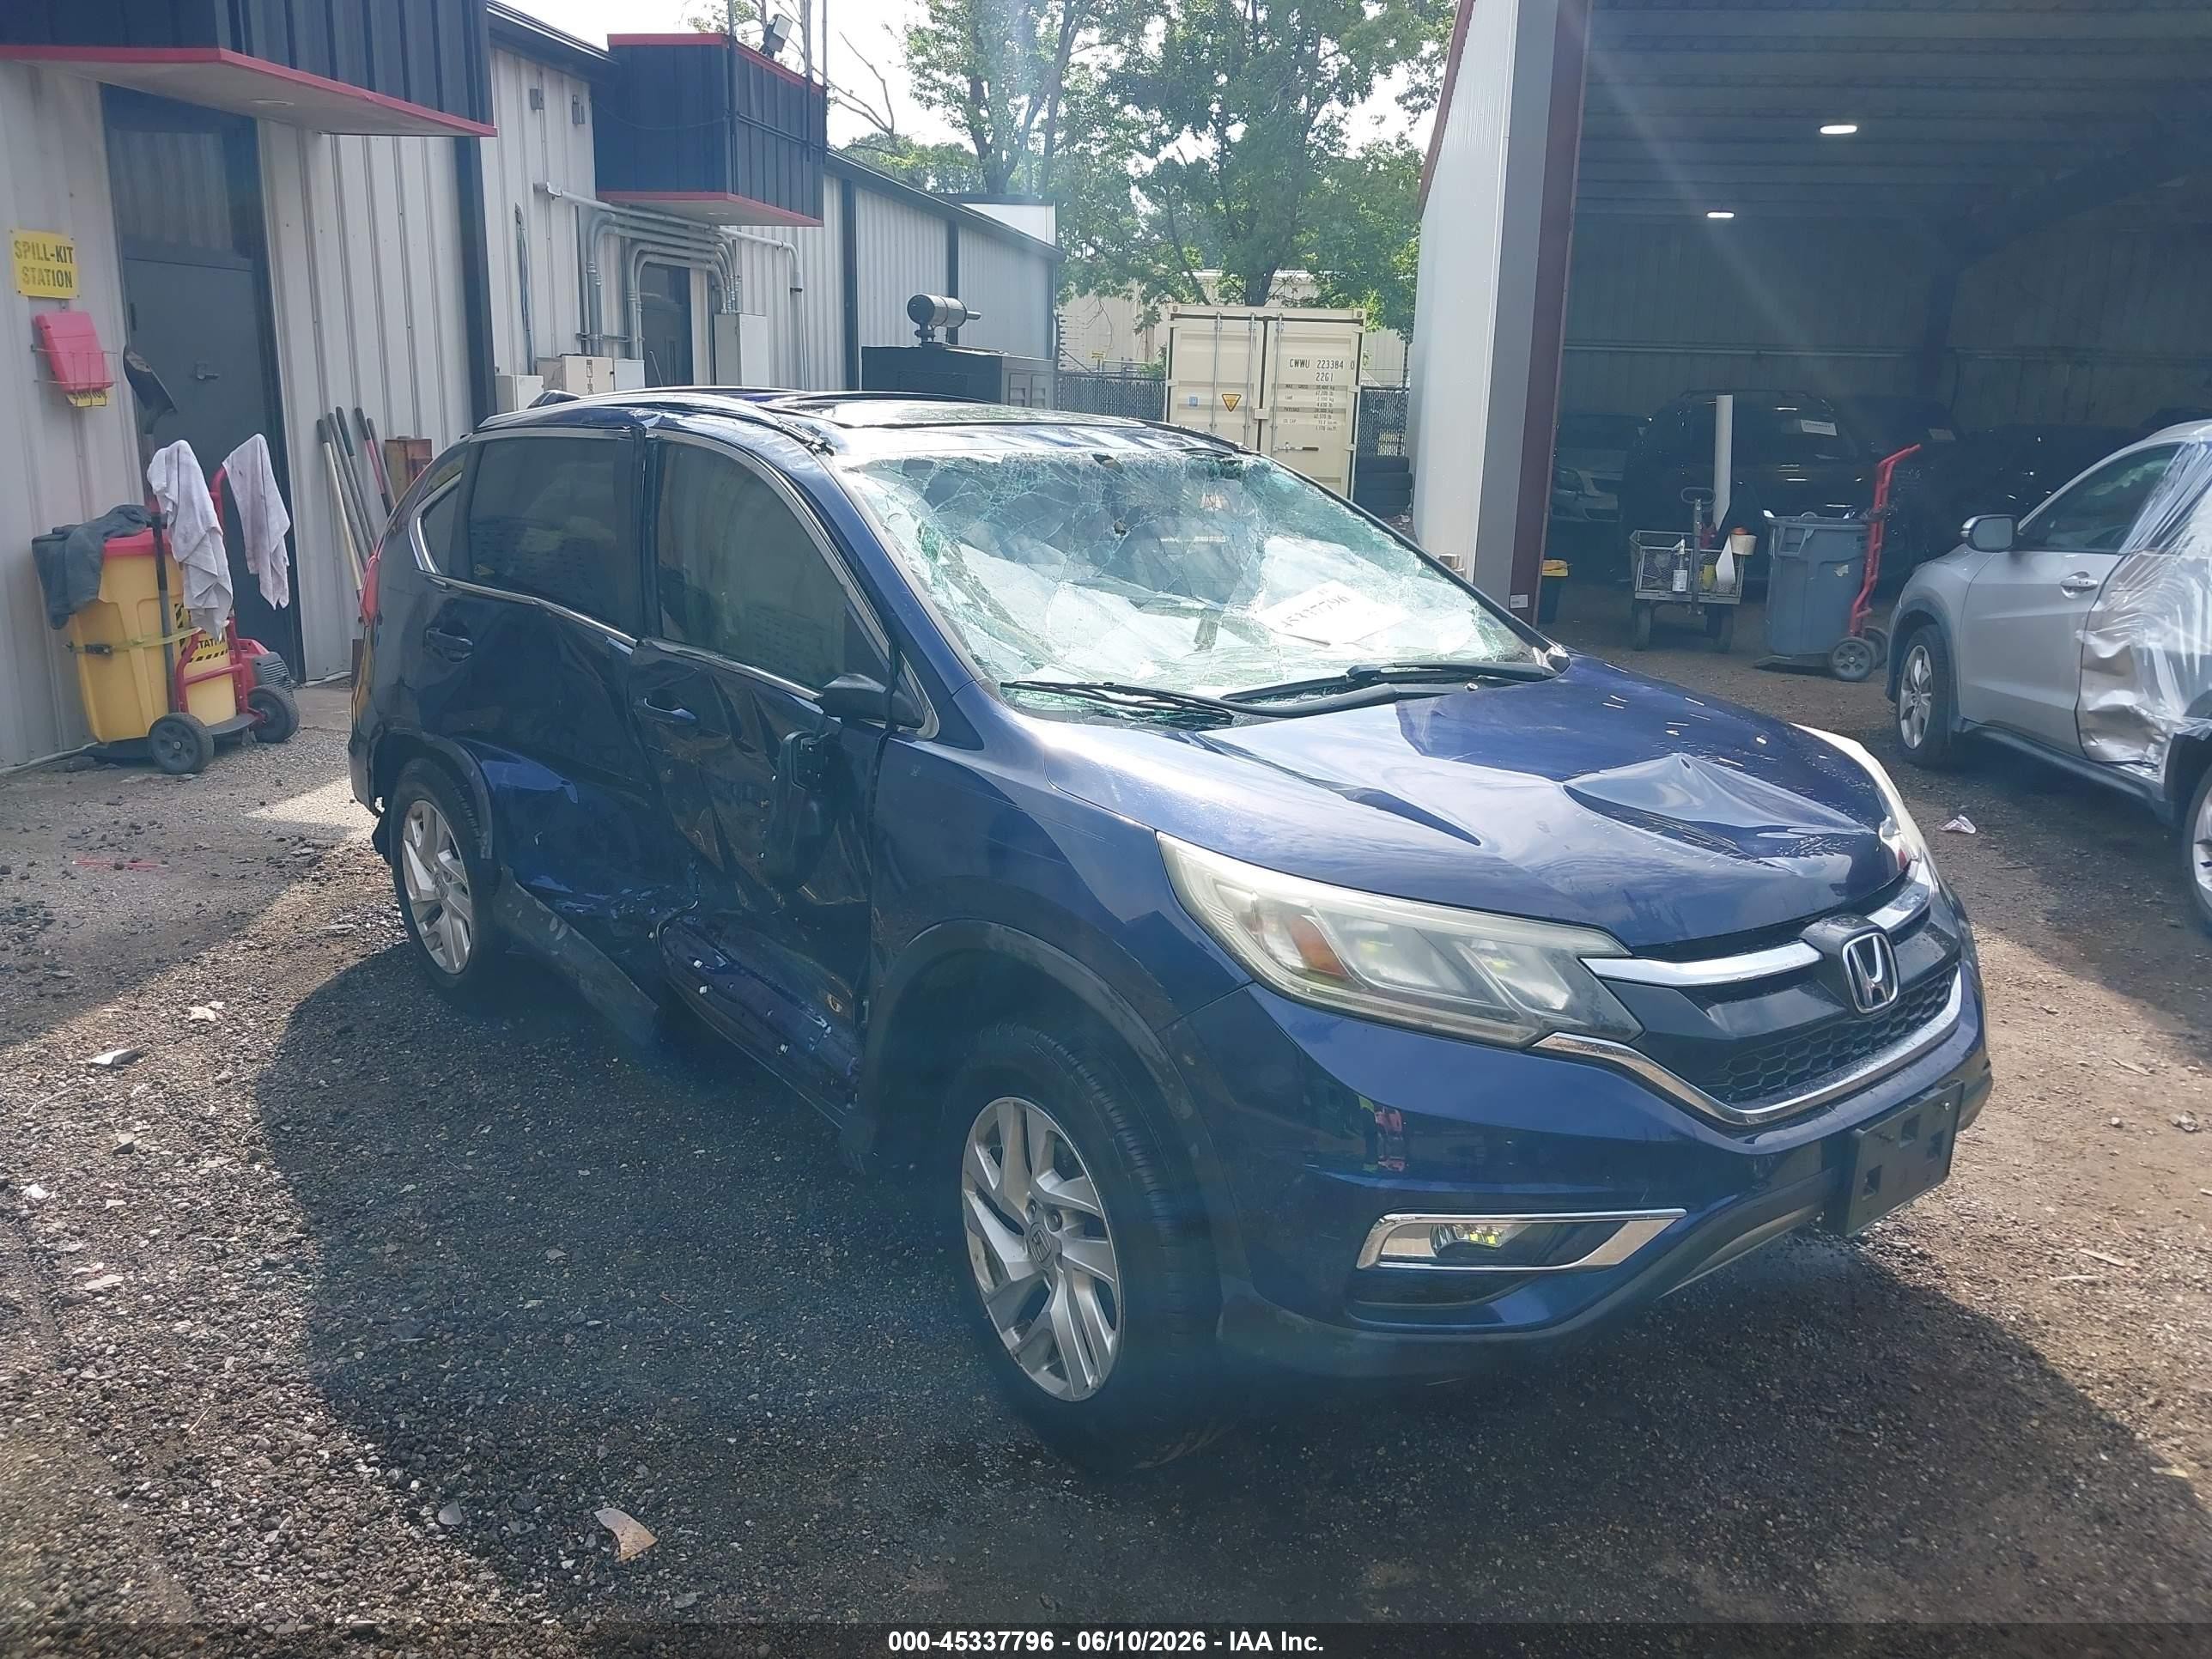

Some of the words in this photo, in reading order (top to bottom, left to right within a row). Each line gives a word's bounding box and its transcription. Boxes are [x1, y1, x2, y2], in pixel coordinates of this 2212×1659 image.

[14, 240, 73, 264] SPILL-KIT
[22, 266, 72, 288] STATION
[1289, 358, 1310, 369] CWWU
[1316, 359, 1344, 369] 223384
[1350, 361, 1355, 370] 0
[1316, 372, 1334, 382] 22G1
